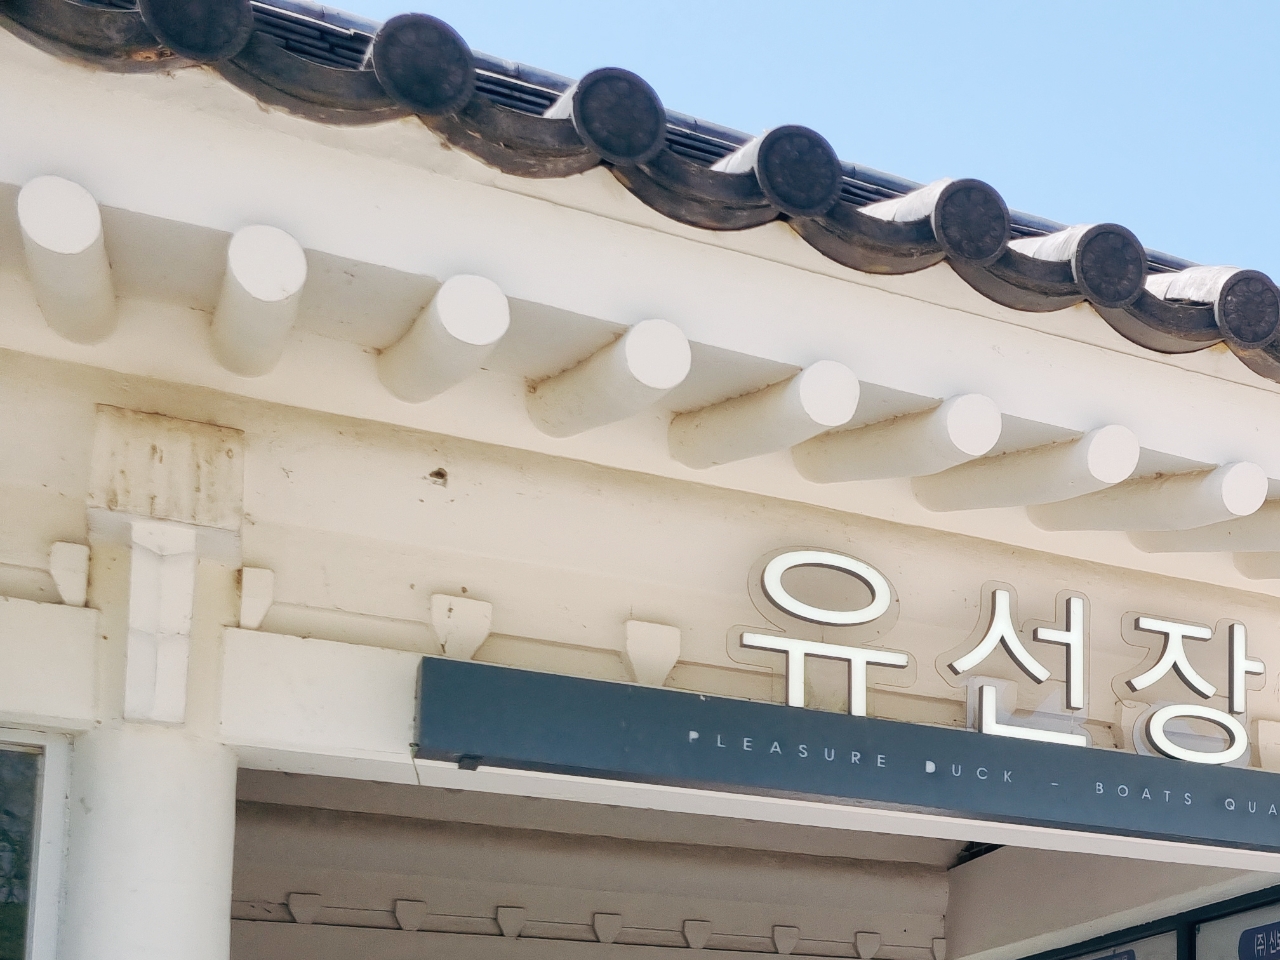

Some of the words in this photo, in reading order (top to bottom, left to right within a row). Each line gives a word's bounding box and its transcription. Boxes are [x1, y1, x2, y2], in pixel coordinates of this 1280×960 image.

[740, 549, 1264, 764] 유선장
[688, 730, 886, 768] PLEASURE
[925, 760, 1012, 783] DUCK
[1095, 781, 1192, 805] BOATS
